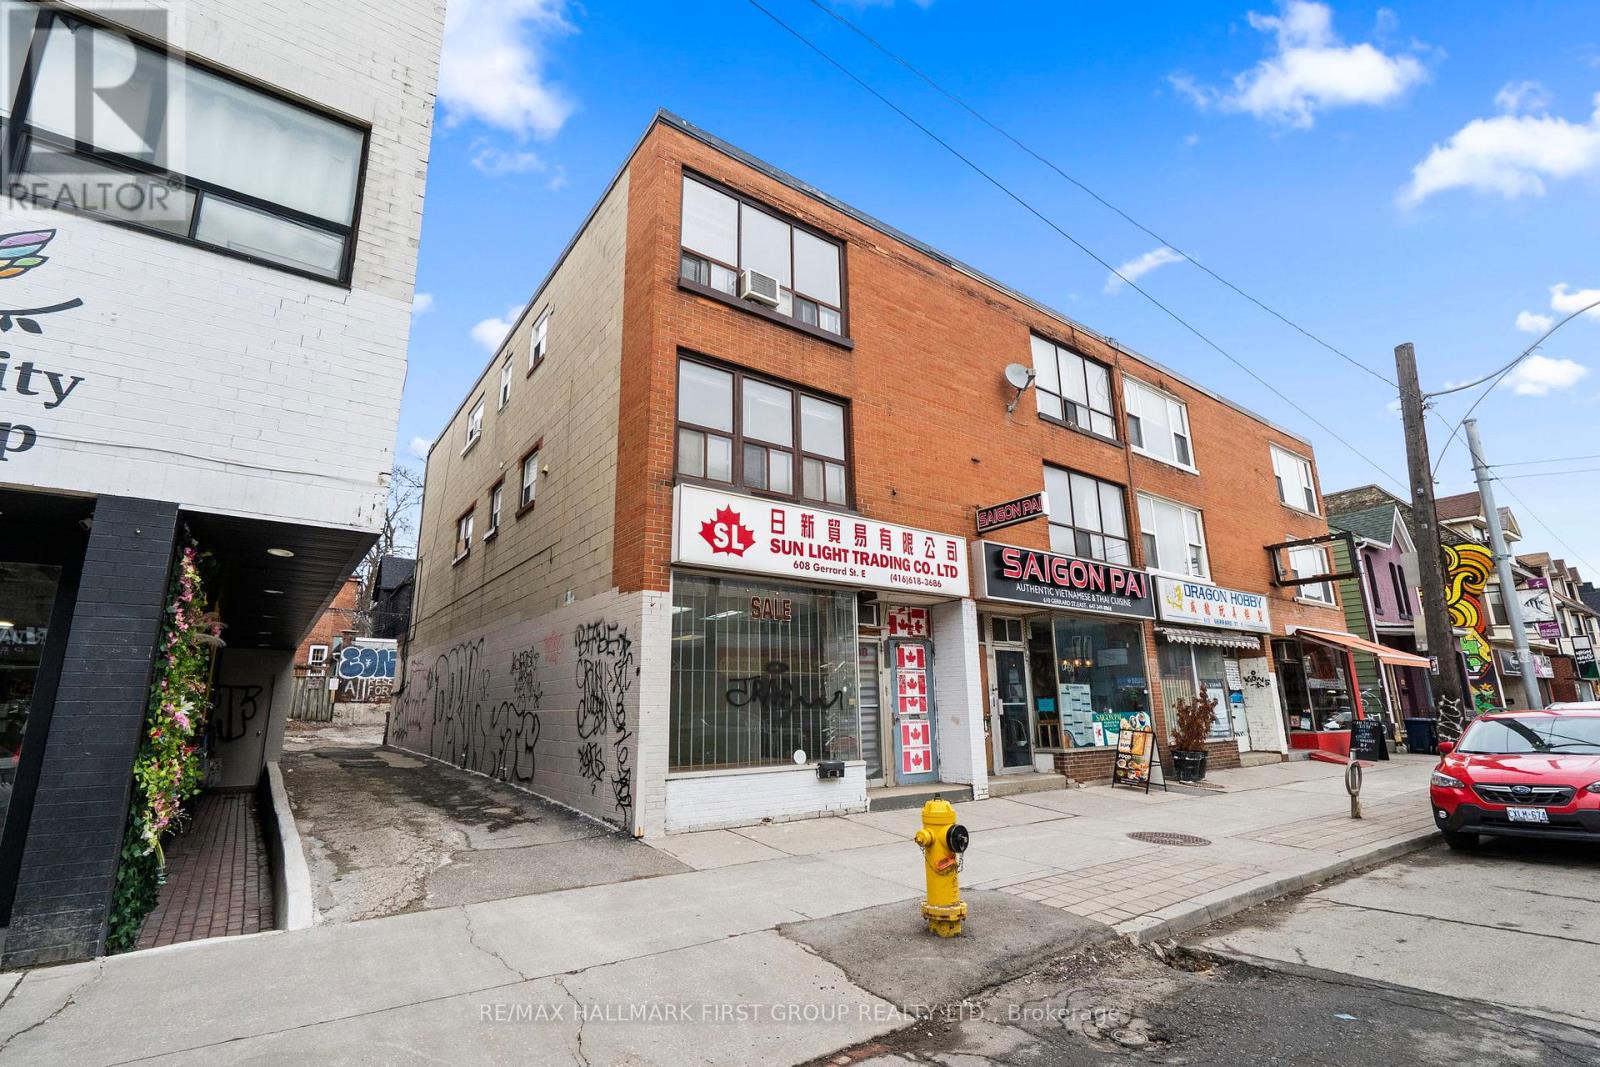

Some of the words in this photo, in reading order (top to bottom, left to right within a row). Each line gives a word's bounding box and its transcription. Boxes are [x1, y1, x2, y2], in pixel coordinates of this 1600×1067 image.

[978, 501, 1022, 528] SAIGON
[1022, 495, 1043, 516] PAI
[713, 521, 744, 551] SL
[770, 508, 958, 563] 日新貿易有限公司
[770, 538, 808, 558] SUN
[808, 542, 849, 564] LIGHT
[853, 550, 911, 573] TRADING
[913, 560, 935, 576] CO.
[937, 563, 959, 579] LTD
[793, 560, 811, 571] 608
[813, 562, 848, 577] Gerrard
[849, 566, 859, 578] St.
[861, 569, 866, 578] E
[1001, 546, 1106, 593] SAIGON
[1109, 567, 1147, 599] PAI
[751, 596, 792, 622] SALE
[1016, 583, 1055, 596] AUTHENTIC
[1055, 588, 1092, 602] VIETNAMESE
[1096, 595, 1110, 604] THAI
[1110, 597, 1132, 607] CUISINE
[1183, 584, 1228, 604] DRAGON
[1230, 593, 1262, 608] HOBBY
